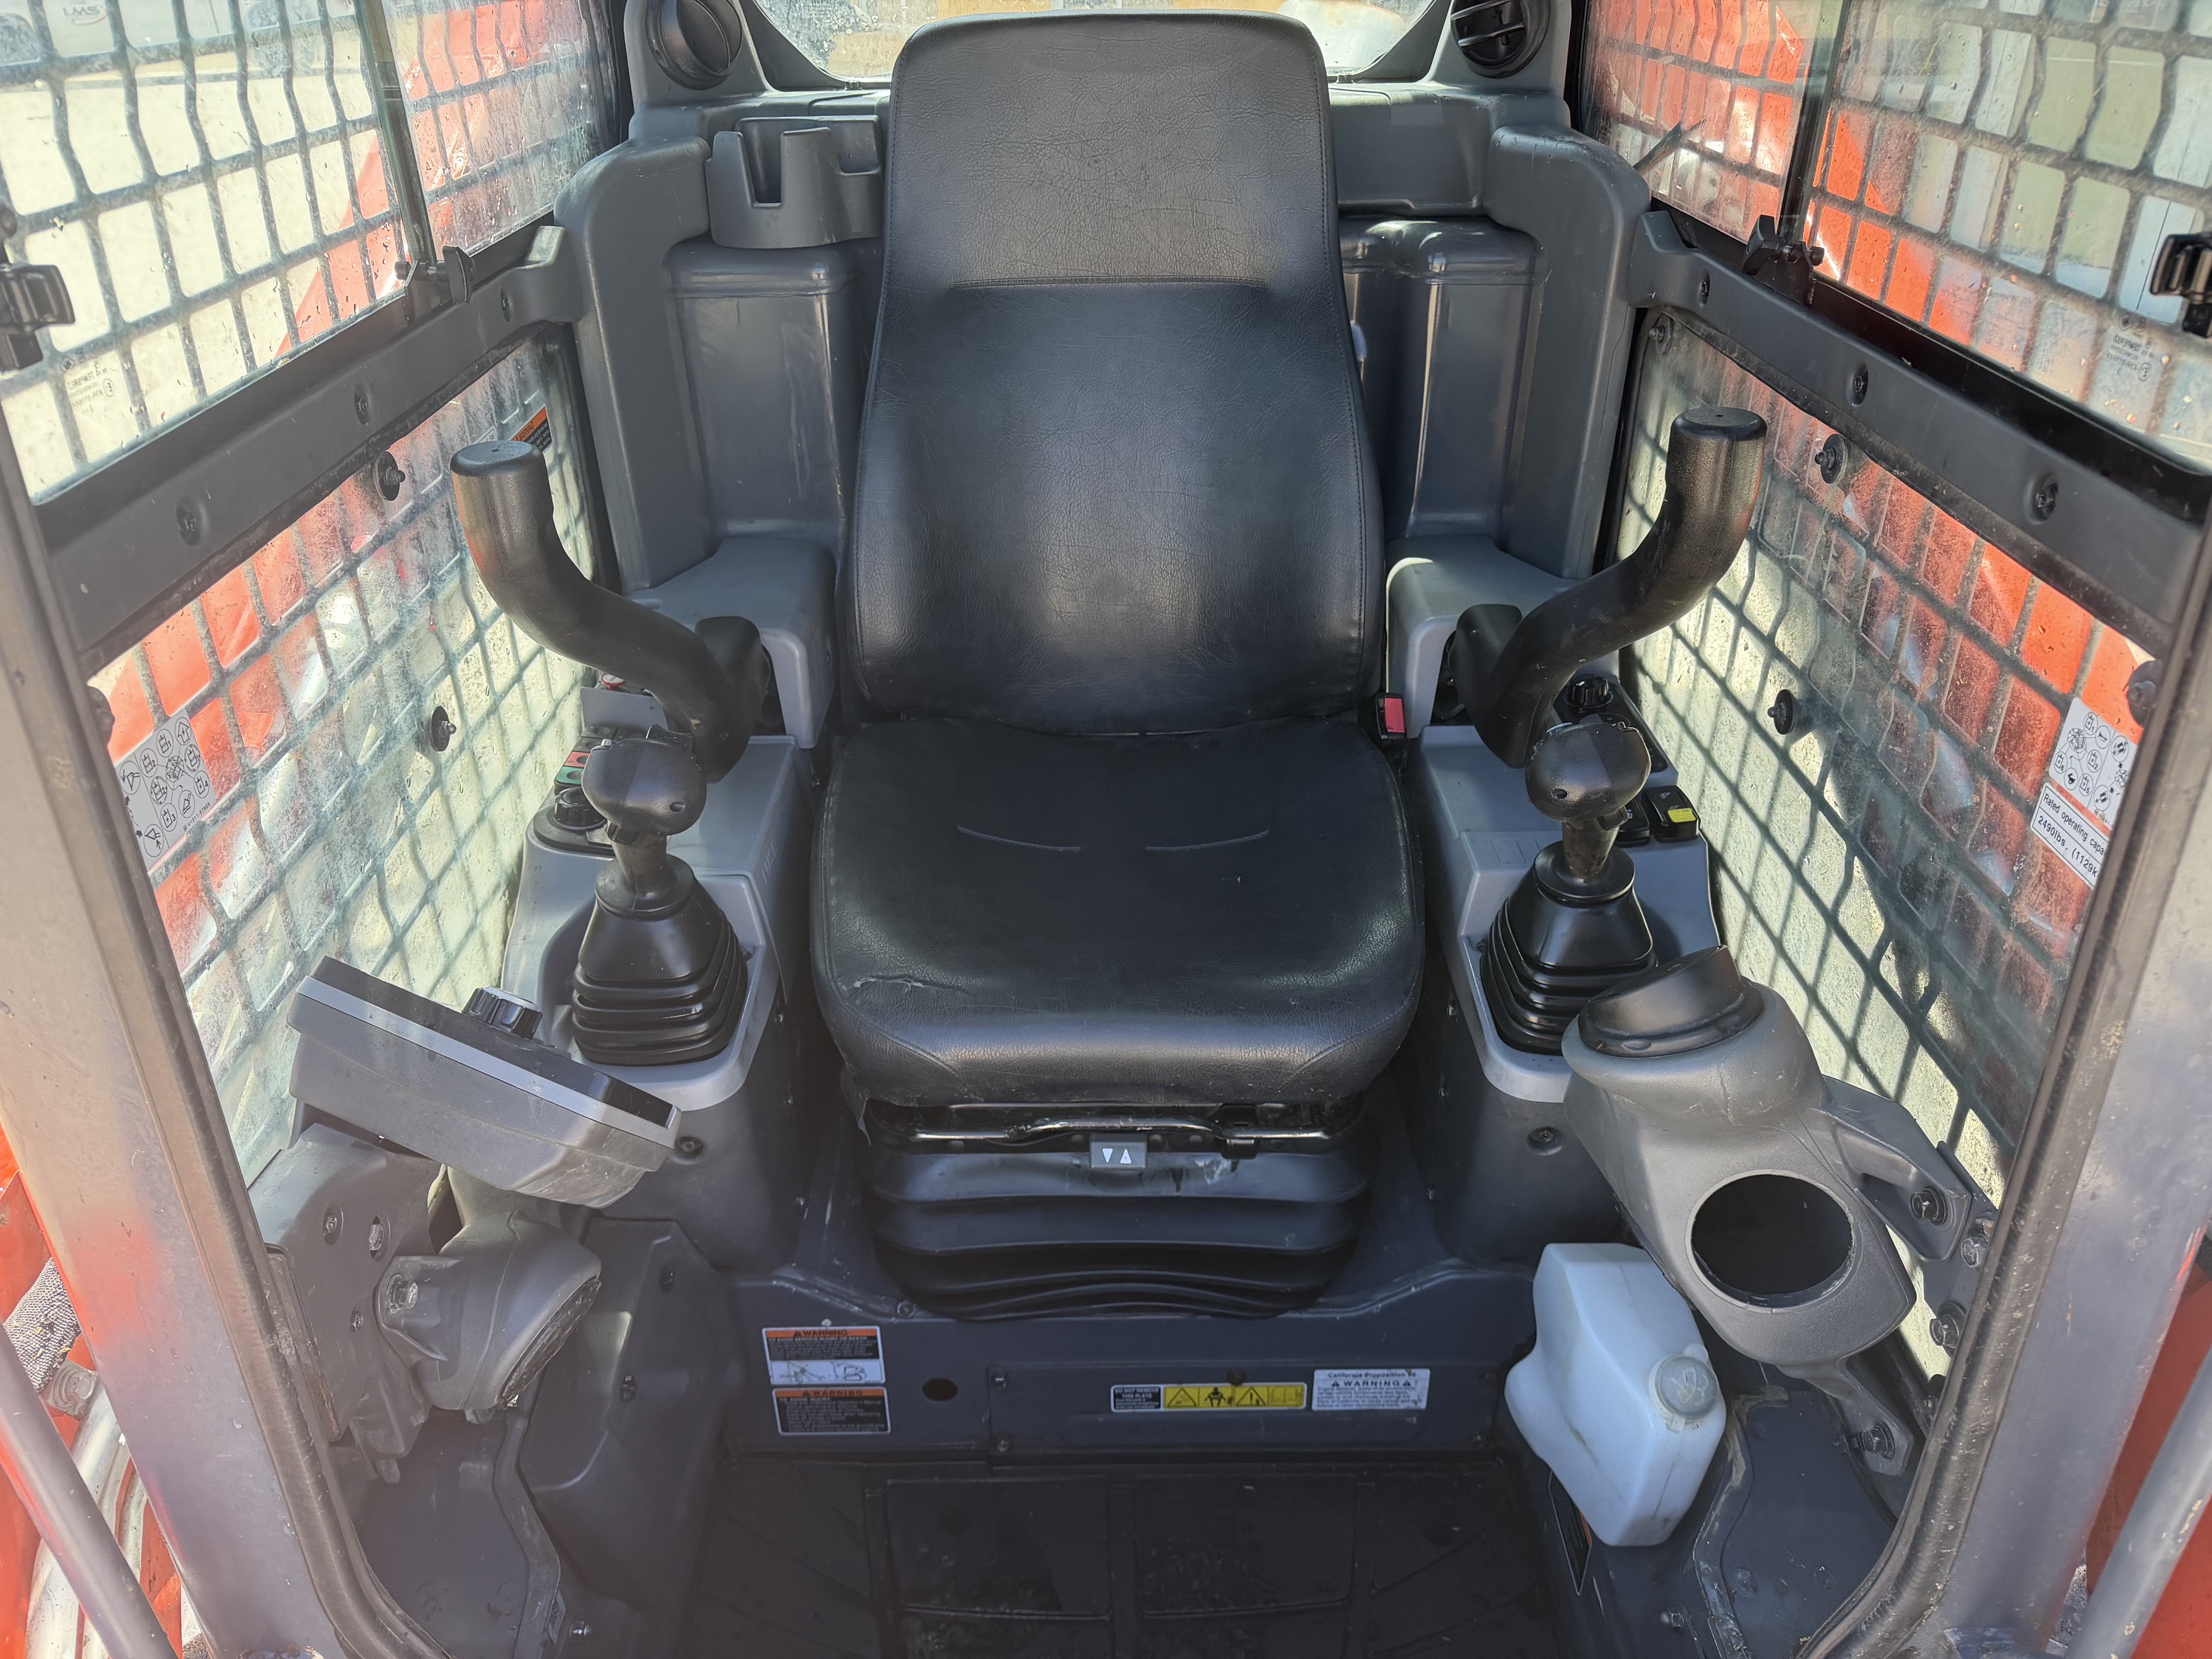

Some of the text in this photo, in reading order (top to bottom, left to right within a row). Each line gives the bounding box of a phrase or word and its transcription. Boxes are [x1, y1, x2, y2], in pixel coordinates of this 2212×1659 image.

[2043, 792, 2060, 814] Rated
[2061, 812, 2088, 842] operating
[2038, 816, 2068, 850] 2490lbs.
[2071, 848, 2098, 878] (1129k
